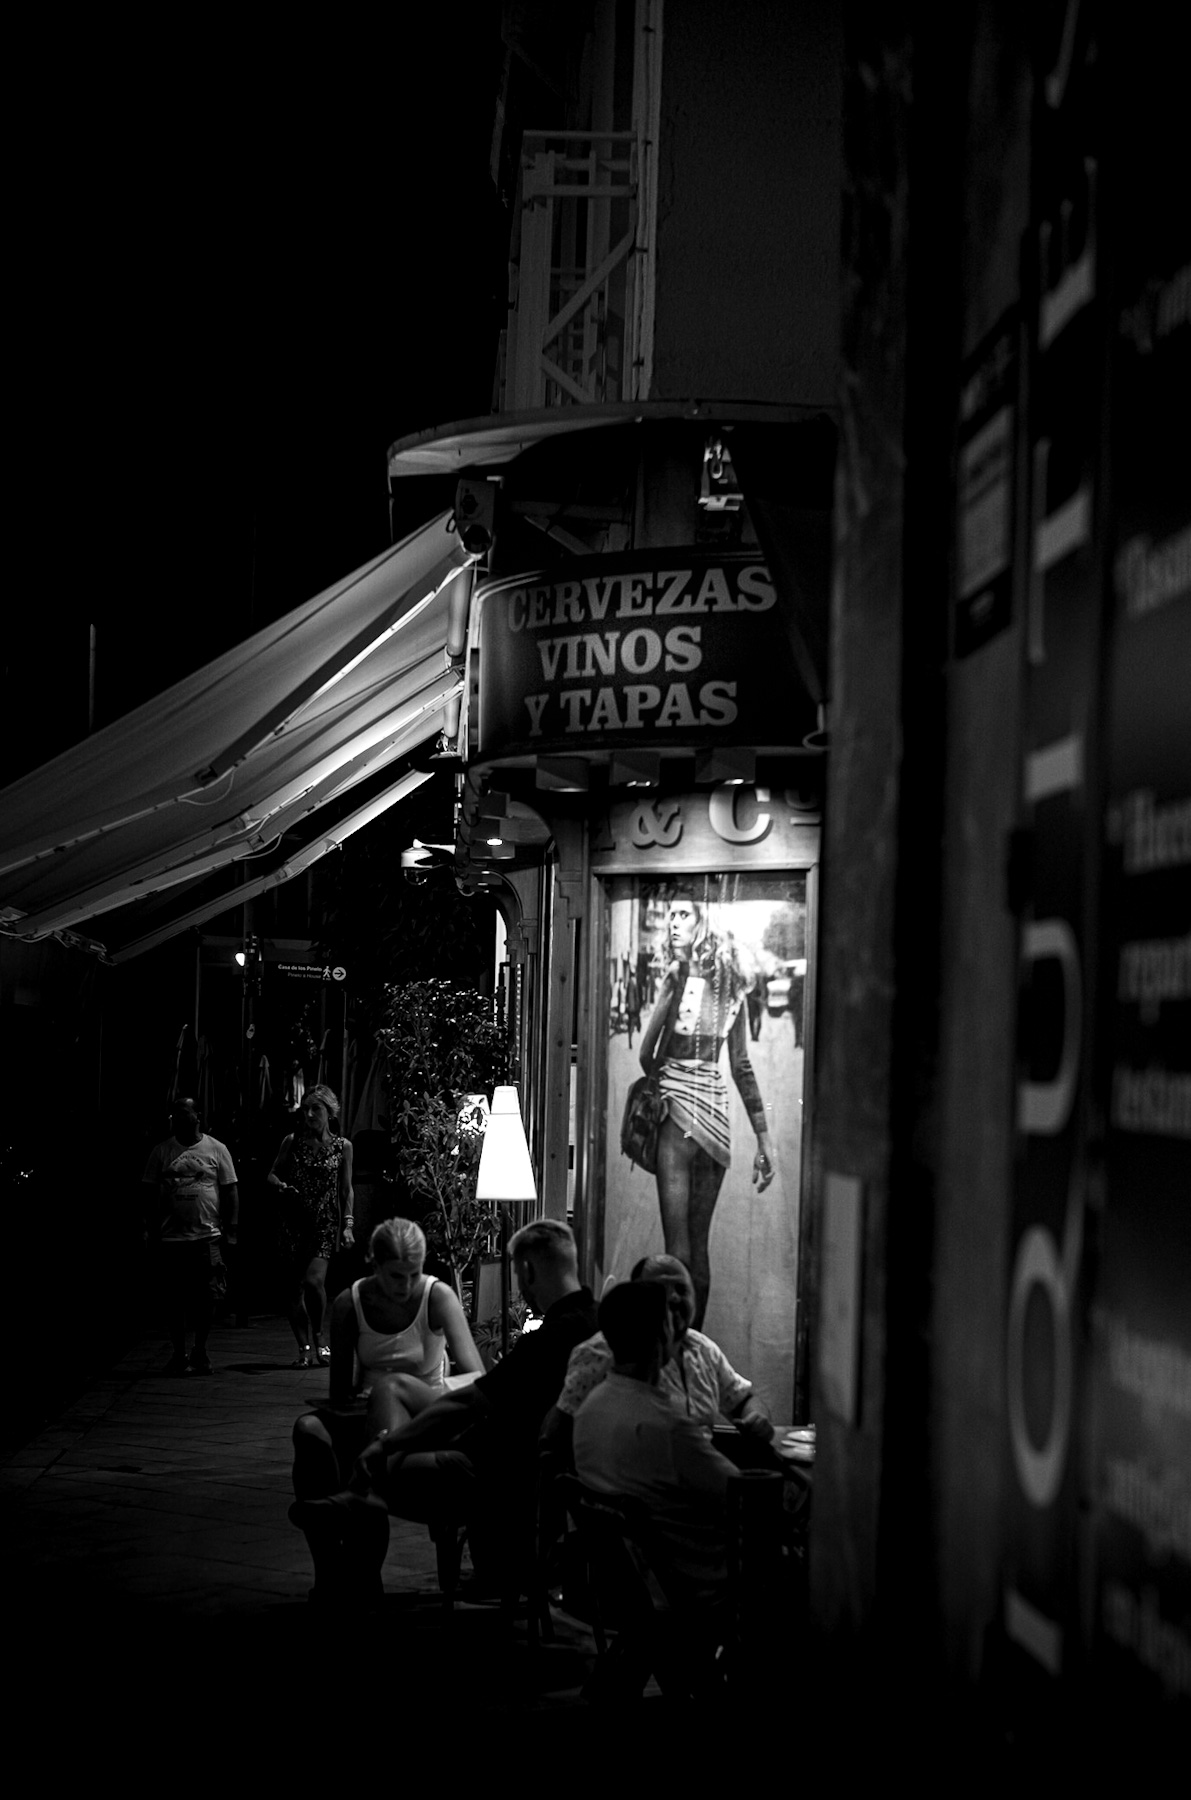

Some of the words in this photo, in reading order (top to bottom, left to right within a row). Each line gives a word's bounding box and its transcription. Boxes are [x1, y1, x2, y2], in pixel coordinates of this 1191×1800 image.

[508, 566, 777, 632] CERVEZAS
[536, 625, 703, 682] VINOS
[524, 694, 550, 737] Y
[560, 680, 739, 734] TAPAS
